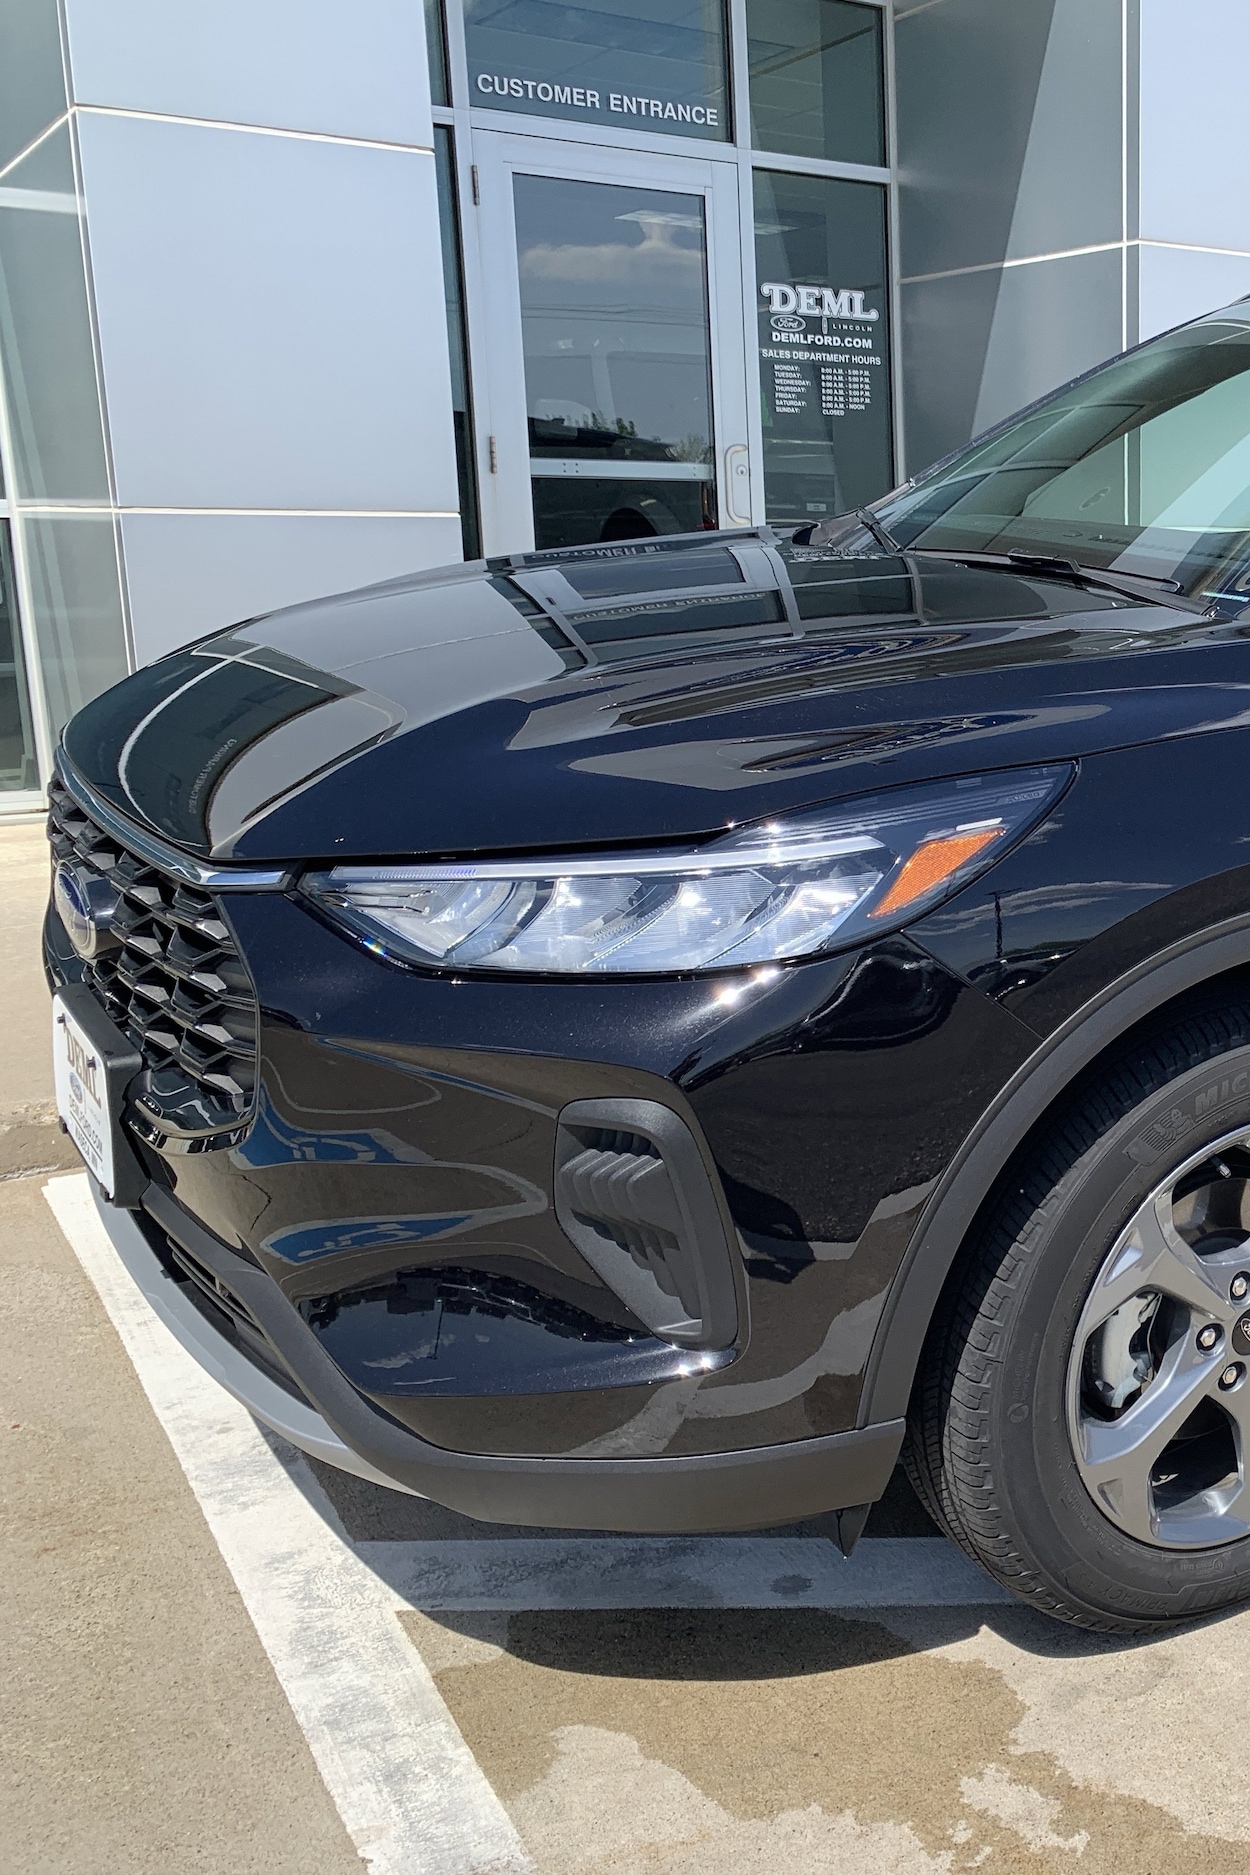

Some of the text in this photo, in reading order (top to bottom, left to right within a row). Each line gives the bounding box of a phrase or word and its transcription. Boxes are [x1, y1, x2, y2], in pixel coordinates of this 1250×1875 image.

[477, 73, 719, 127] CUSTOMER ENTRANCE
[760, 282, 879, 321] DEML
[832, 323, 873, 331] LINCOLN
[771, 331, 873, 349] DEMLFORD.COM
[761, 349, 881, 366] SALES DEPARTMENT HOURS
[1099, 1583, 1170, 1612] PRIMACY
